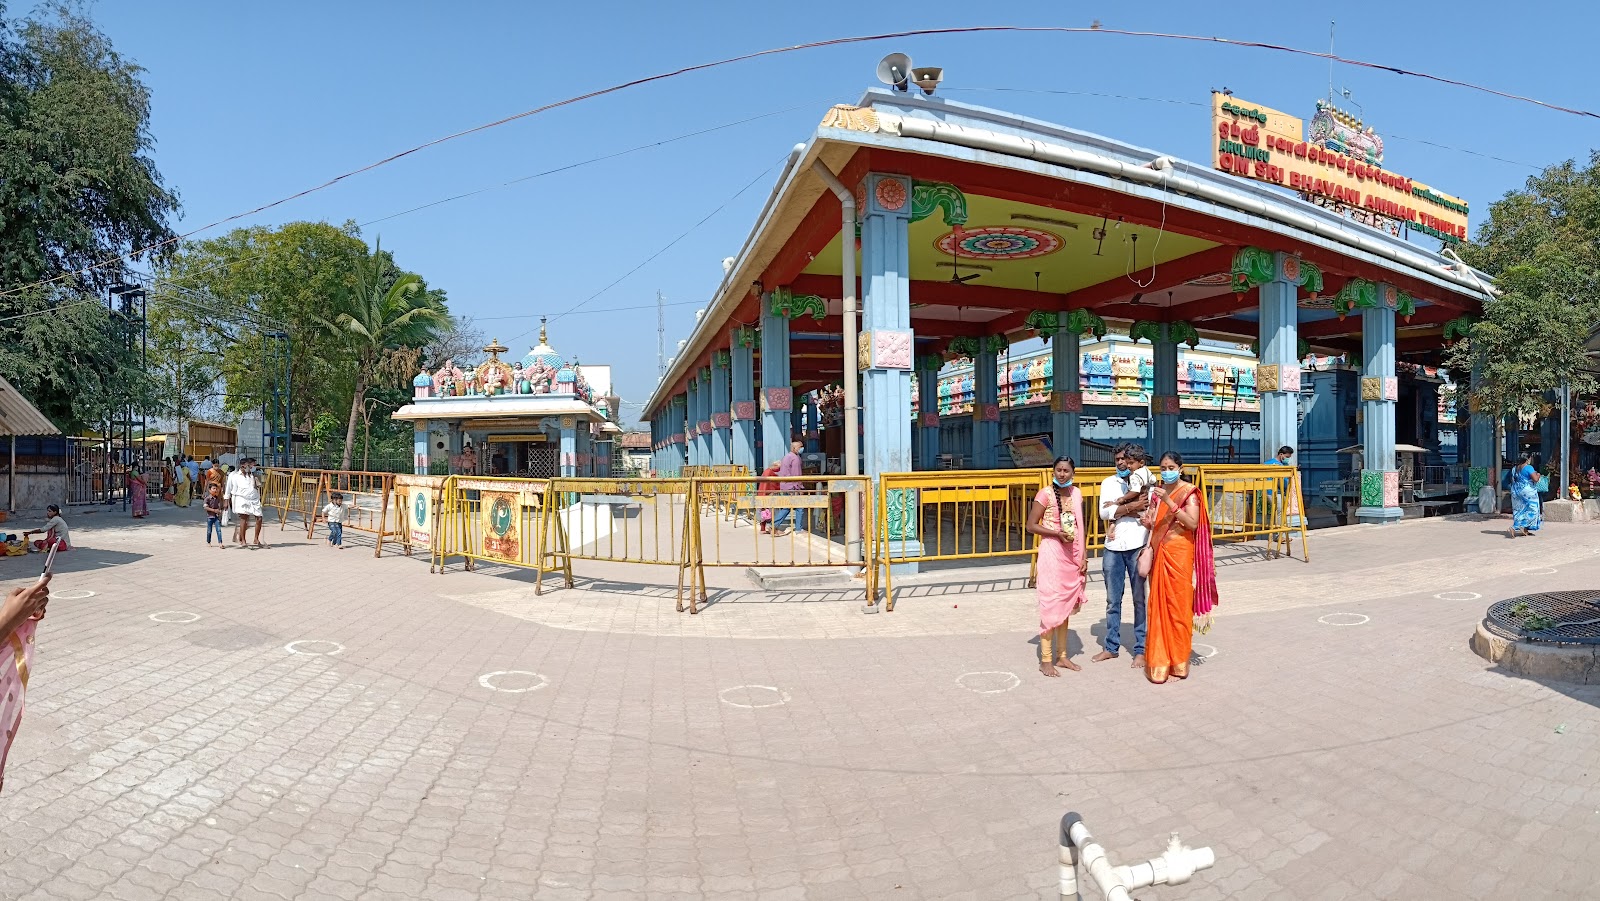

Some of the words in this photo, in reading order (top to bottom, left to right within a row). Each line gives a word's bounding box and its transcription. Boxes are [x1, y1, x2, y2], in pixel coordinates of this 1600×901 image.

[1219, 139, 1270, 162] ARULMIGU
[1266, 135, 1307, 158] பவானி
[1308, 147, 1346, 169] அம்மன்
[1347, 159, 1412, 193] திருக்கோயில்
[1220, 153, 1249, 175] OM
[1255, 161, 1284, 182] SRI
[1290, 171, 1360, 204] BHAVANI
[1364, 194, 1416, 221] AMMAN
[1419, 211, 1466, 239] TEMPLE
